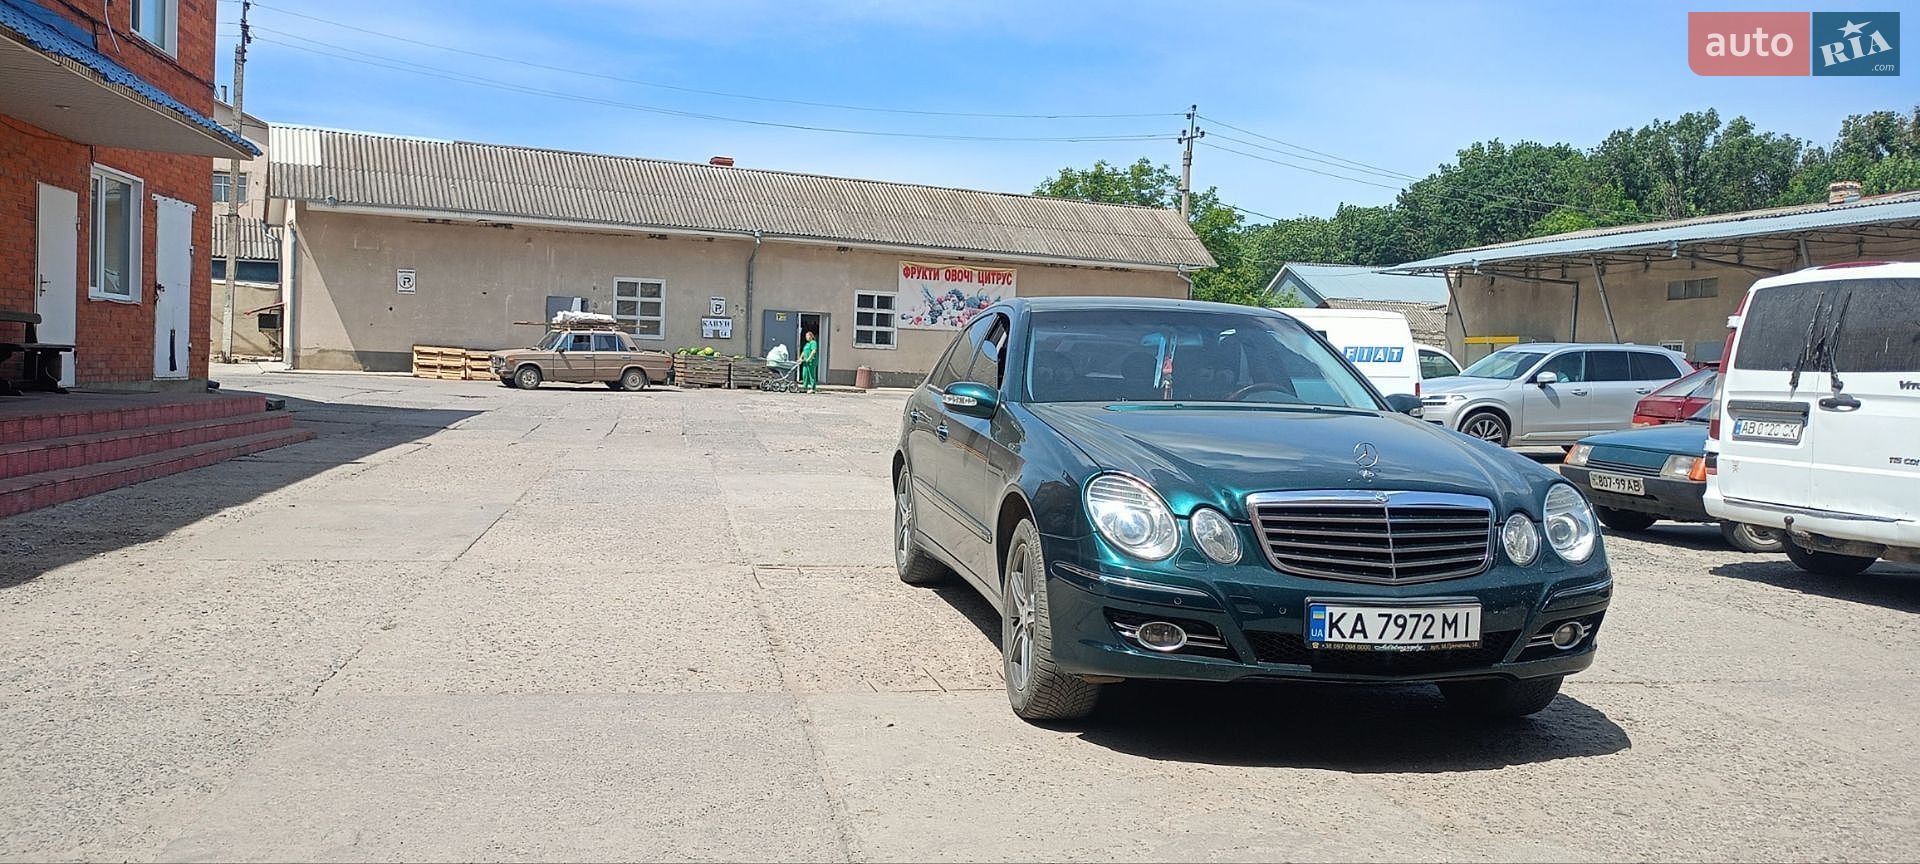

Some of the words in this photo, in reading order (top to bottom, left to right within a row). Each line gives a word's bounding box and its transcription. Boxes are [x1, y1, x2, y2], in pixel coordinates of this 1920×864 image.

[902, 265, 940, 281] ФРУКТИ
[944, 268, 973, 283] ОВОЧІ
[977, 270, 1013, 287] ЦИТРУС
[1344, 347, 1403, 362] FIAT
[1311, 628, 1324, 638] UA
[1328, 611, 1368, 640] KA
[1378, 613, 1435, 640] 7972
[1441, 611, 1470, 639] MI
